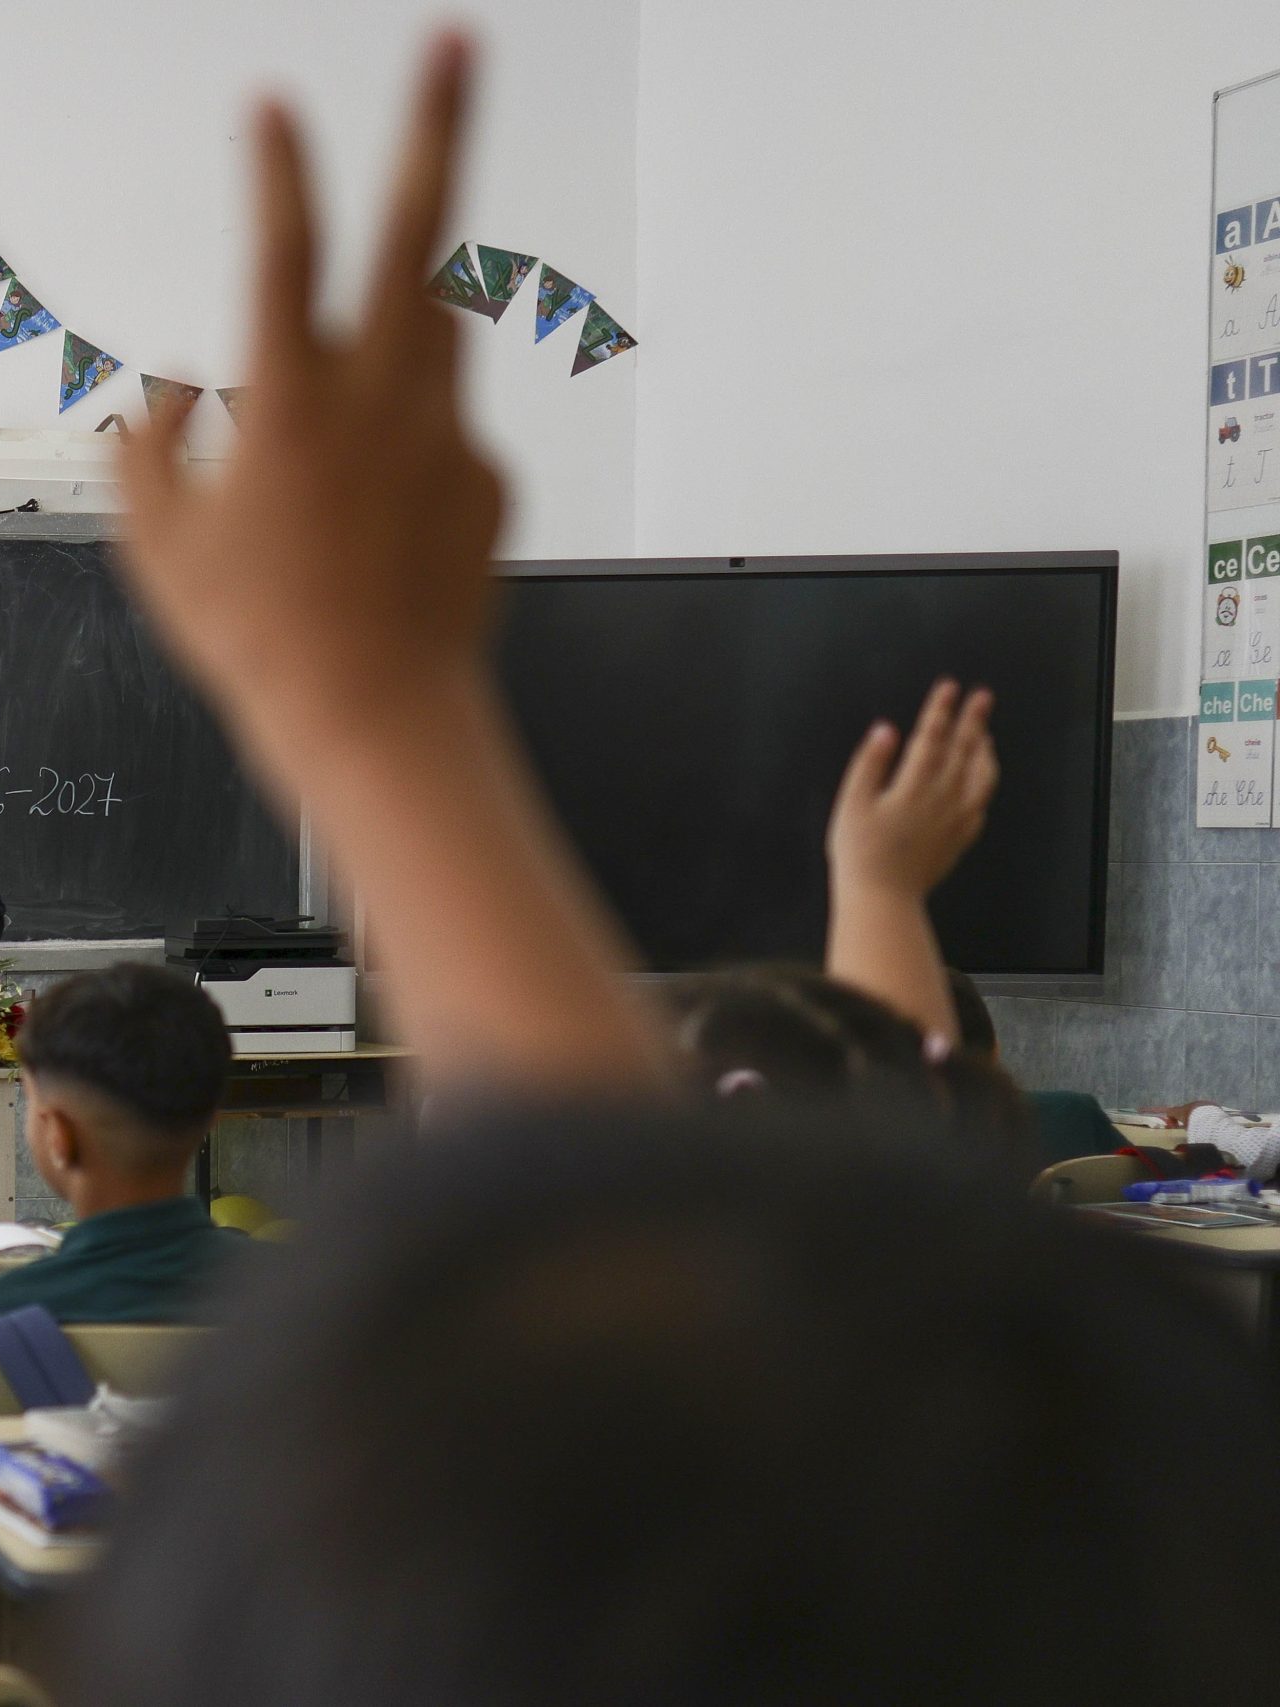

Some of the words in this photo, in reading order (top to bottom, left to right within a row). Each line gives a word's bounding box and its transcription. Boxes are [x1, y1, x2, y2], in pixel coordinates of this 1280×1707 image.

[1225, 221, 1240, 248] a
[0, 308, 32, 339] S
[490, 261, 513, 299] X
[545, 288, 571, 322] Y
[1226, 370, 1236, 400] t
[1258, 357, 1278, 393] T
[1214, 558, 1238, 579] ce
[1247, 544, 1280, 575] Ce
[1203, 696, 1232, 715] che
[1240, 693, 1273, 713] Che
